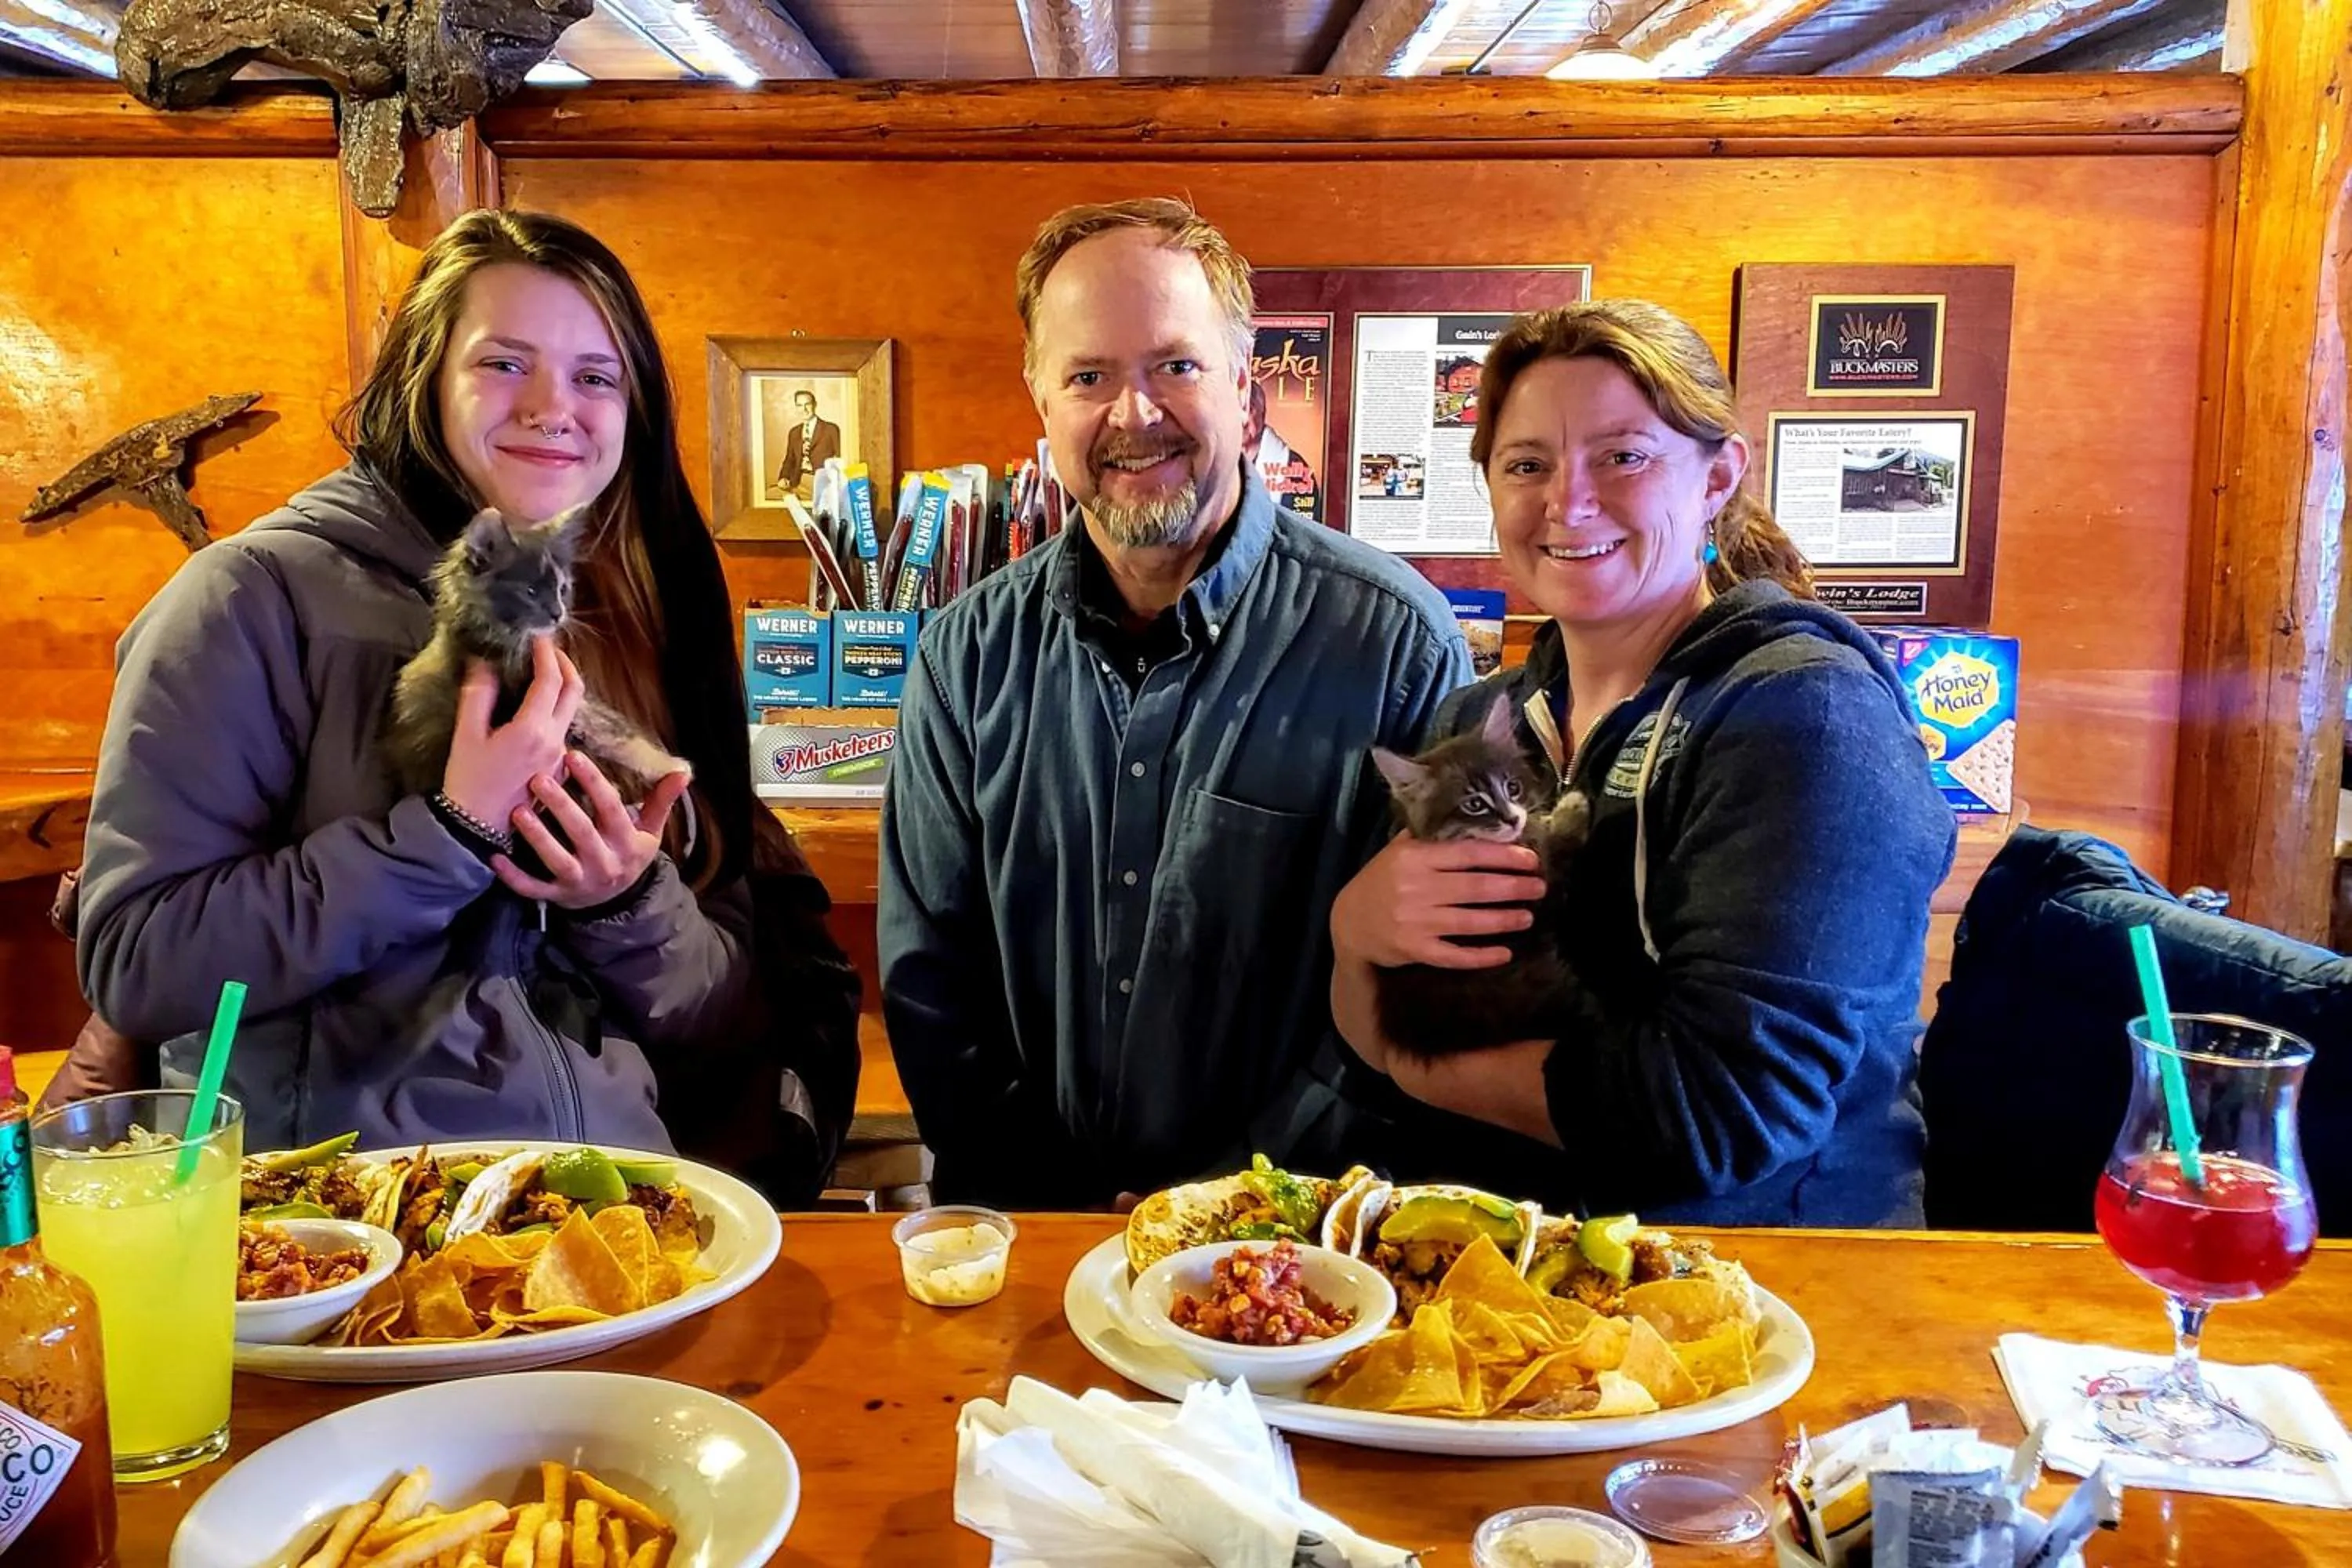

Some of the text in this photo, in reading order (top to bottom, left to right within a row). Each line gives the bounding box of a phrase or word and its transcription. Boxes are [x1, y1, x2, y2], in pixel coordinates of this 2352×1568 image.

[1251, 338, 1321, 383] aska
[1830, 361, 1919, 373] BUCKMASTERS
[1784, 428, 1912, 439] What's Your Favorite Eatery?
[854, 486, 874, 550] WERNER
[912, 496, 941, 557] WERNER
[1816, 587, 1920, 599] win's Lodge
[757, 617, 818, 634] WERNER
[844, 619, 906, 635] WERNER
[757, 653, 815, 666] CLASSIC
[844, 655, 902, 666] PEPPERONI
[1921, 670, 1992, 698] Honey
[1933, 690, 1984, 713] Maid
[775, 750, 793, 774] 3
[795, 730, 895, 771] Musketeers
